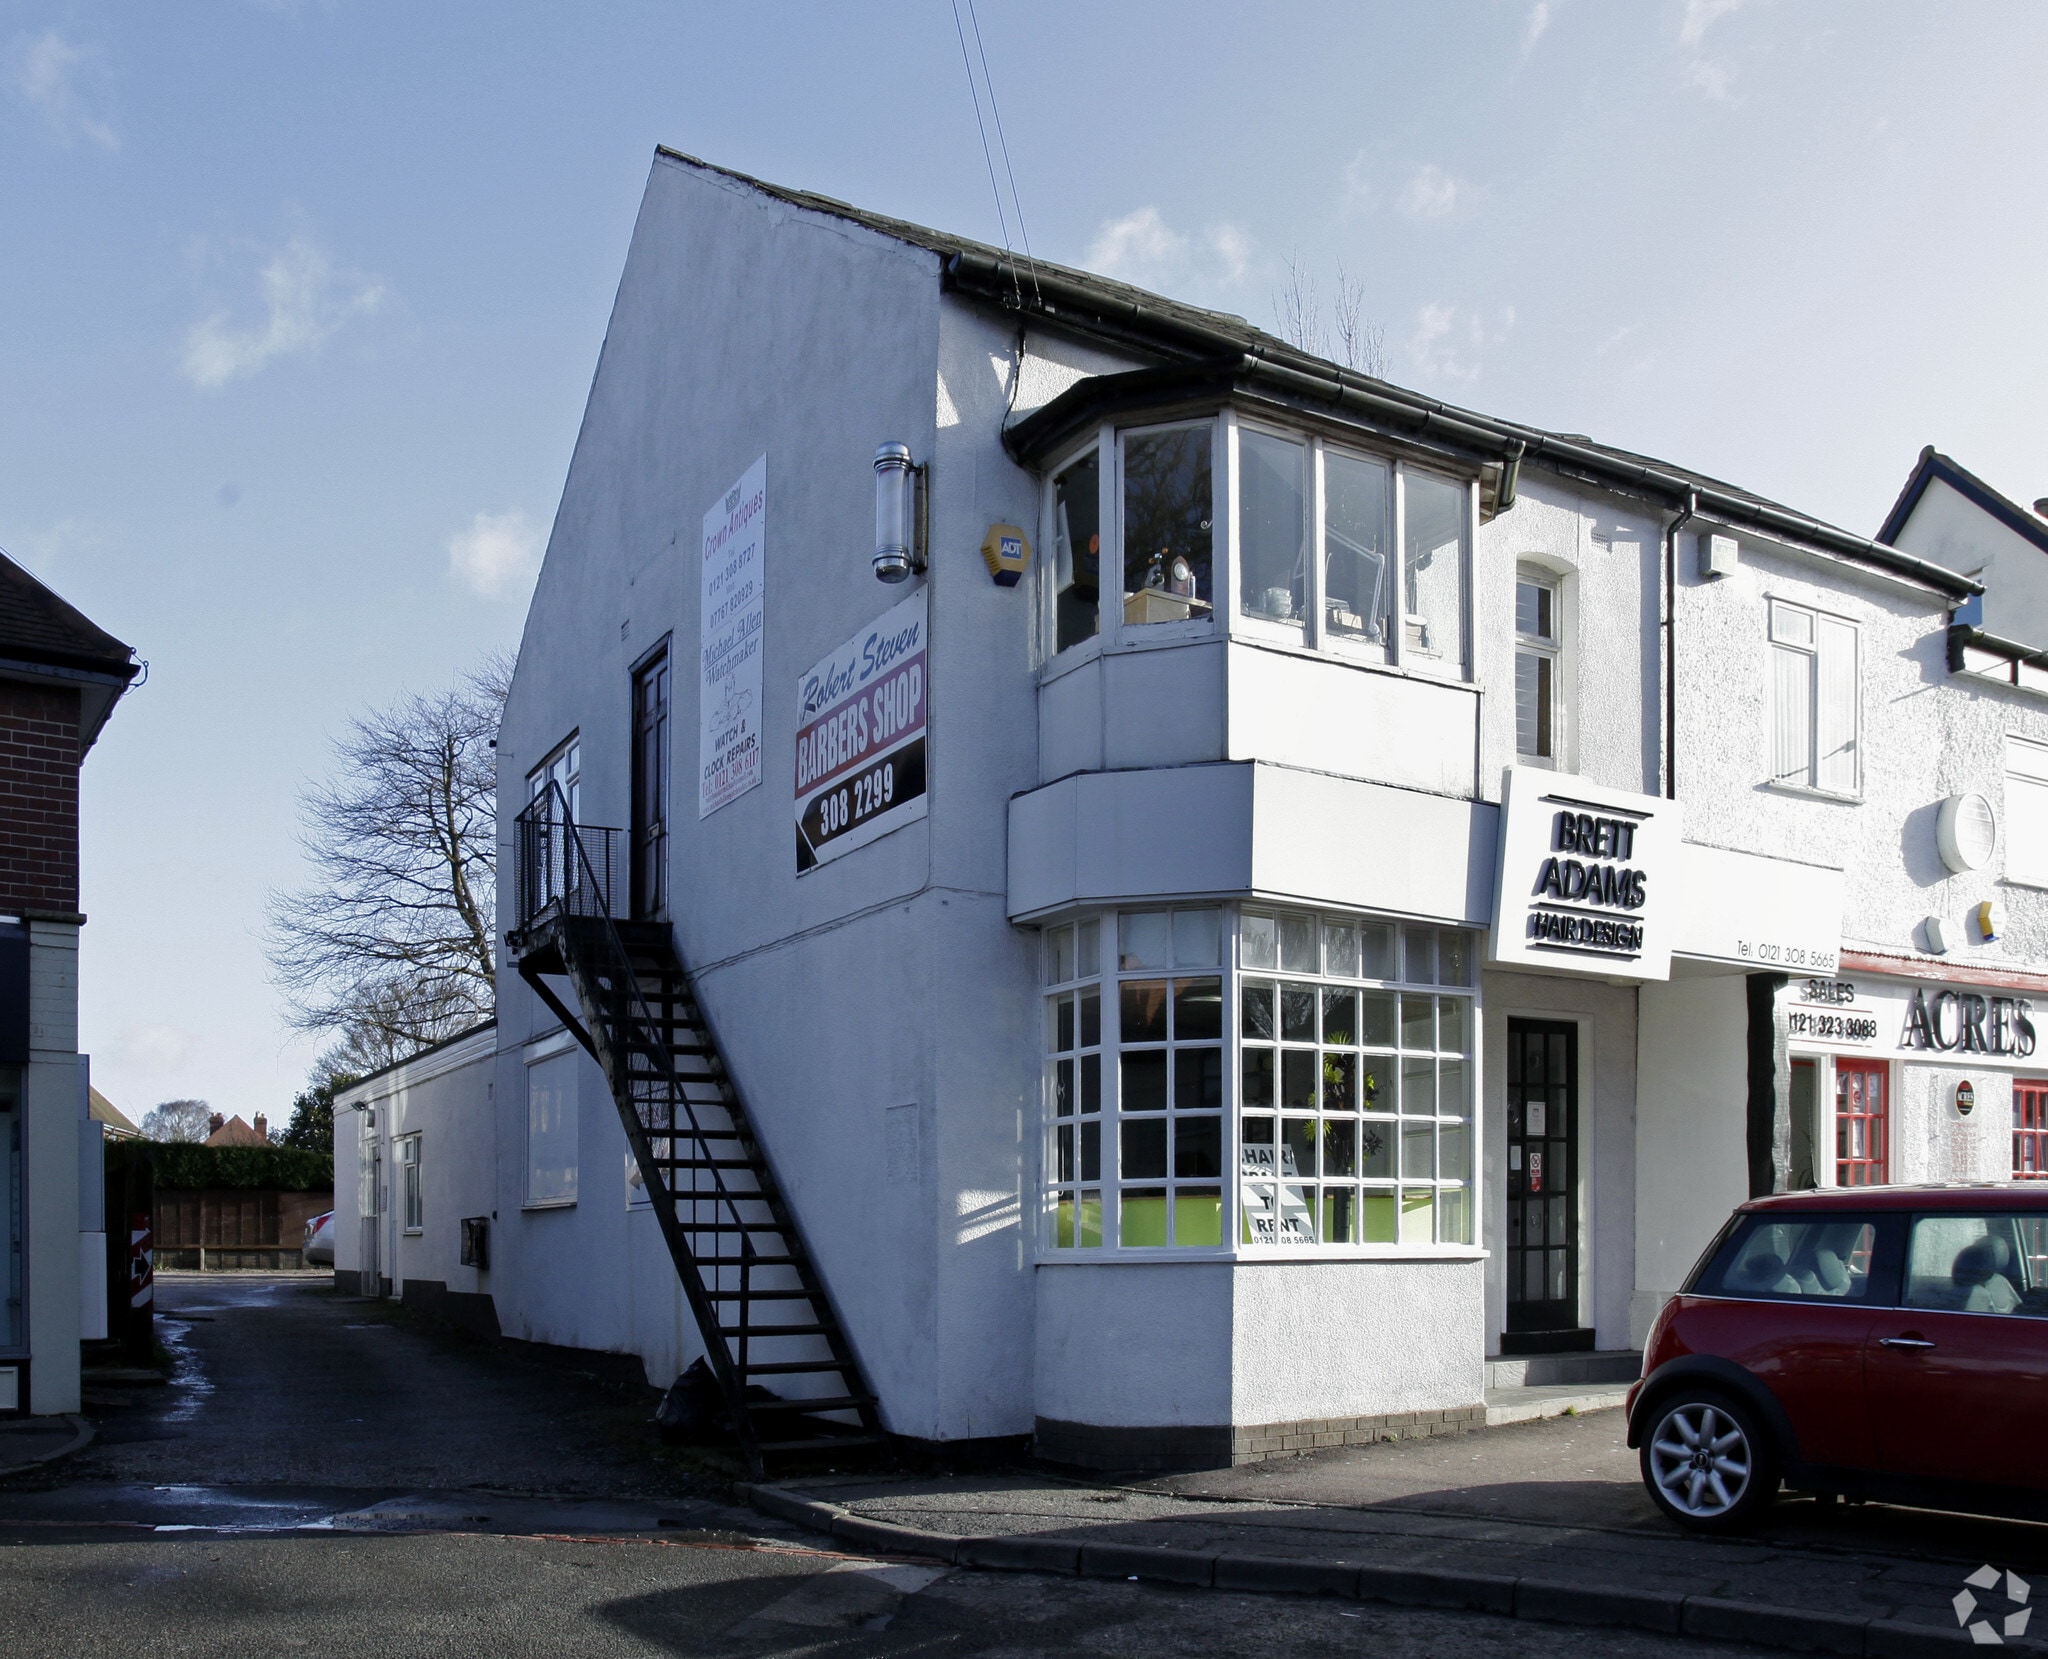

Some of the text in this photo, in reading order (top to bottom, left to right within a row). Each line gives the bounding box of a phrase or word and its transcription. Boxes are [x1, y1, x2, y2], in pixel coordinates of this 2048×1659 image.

[705, 490, 763, 561] Crown Antiques
[1001, 541, 1022, 555] ADT
[708, 542, 756, 597] 0121 308 8727
[709, 580, 753, 629] 07767 820929
[703, 611, 762, 668] Michael Allen
[705, 638, 759, 687] Watchmaker
[801, 621, 920, 721] Robert Steven
[715, 718, 746, 752] WATCH &
[798, 663, 922, 790] BARBERS SHOP
[702, 779, 713, 798] Tel:
[715, 767, 729, 790] 0121
[732, 758, 743, 779] 308
[745, 746, 760, 770] 6117
[704, 732, 756, 780] CLOCK REPAIRS
[820, 788, 849, 837] 308
[854, 763, 894, 820] 2299
[1559, 810, 1638, 860] BRETT
[1537, 857, 1647, 908] ADAMS
[1532, 912, 1643, 949] HAIR DESIGN
[1737, 940, 1835, 968] Tel: 0121 308 5665
[1807, 978, 1855, 1003] SALES
[1818, 1015, 1843, 1035] 323
[1845, 1018, 1877, 1038] 3088
[1902, 987, 2037, 1057] ACRES
